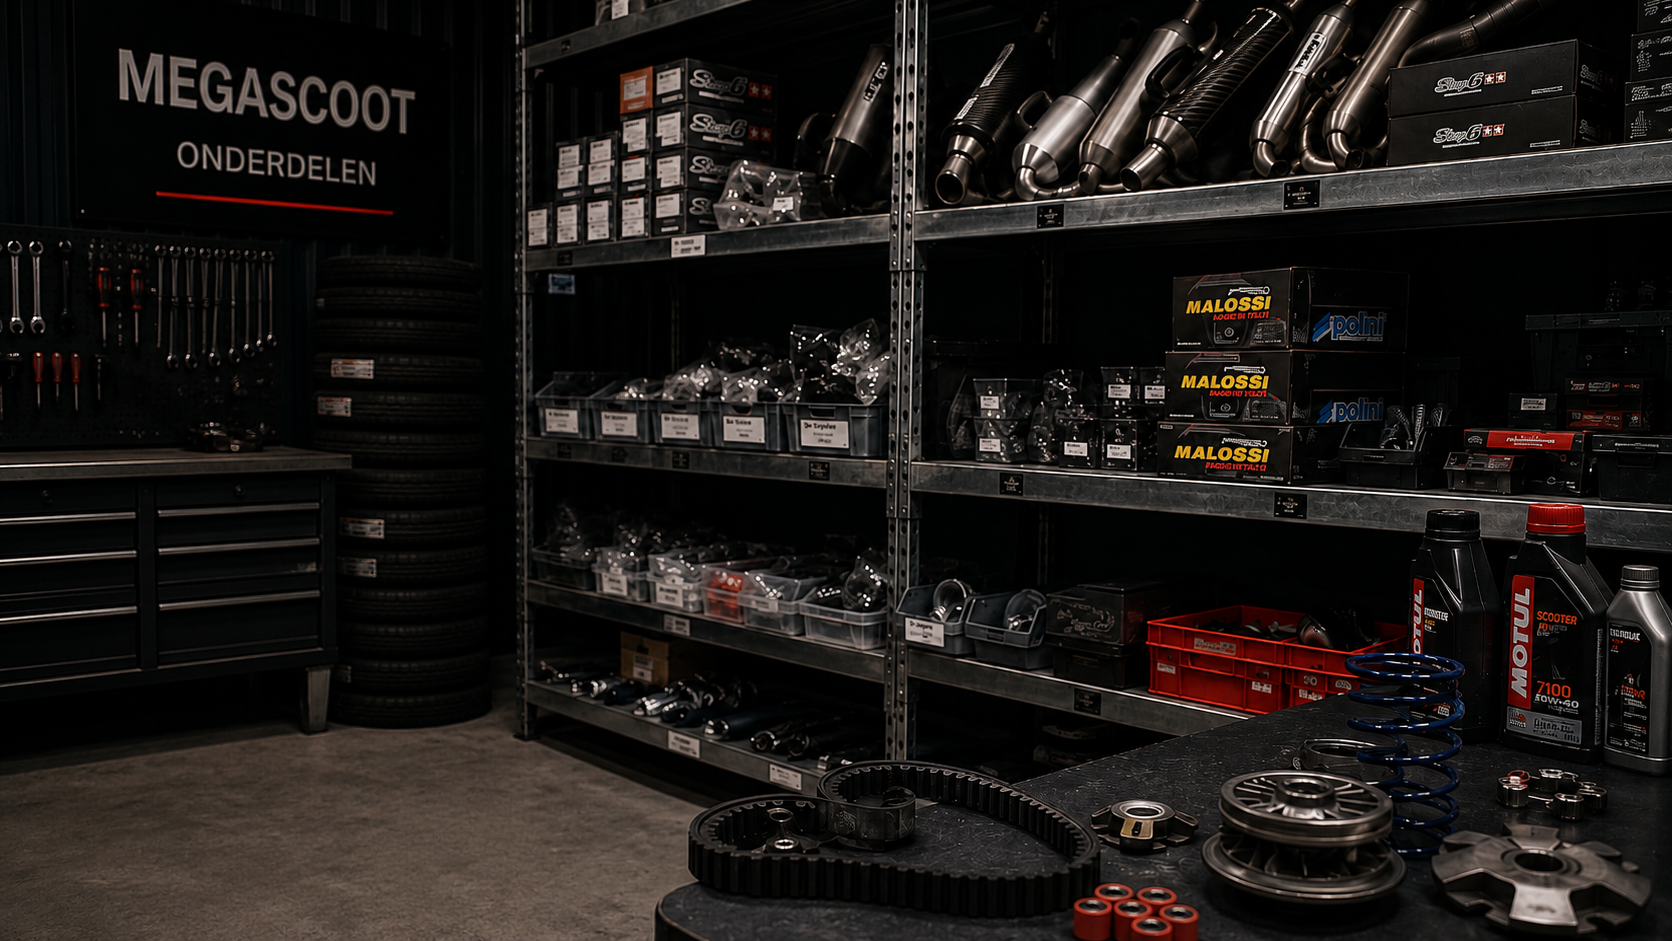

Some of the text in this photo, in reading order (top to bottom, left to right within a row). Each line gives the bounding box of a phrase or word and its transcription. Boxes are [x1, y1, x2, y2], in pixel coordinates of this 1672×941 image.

[118, 47, 416, 135] MEGASCOOT
[176, 140, 377, 187] ONDERDELEN
[1185, 295, 1272, 314] MALOSSI
[1331, 311, 1385, 341] polini
[1180, 375, 1270, 390] MALOSSI
[1331, 397, 1384, 423] polini
[1173, 445, 1270, 463] MALOSSI
[1413, 589, 1422, 654] OTUL
[1536, 610, 1578, 626] SCOOTER
[1511, 587, 1531, 699] MOTUL
[1536, 680, 1572, 699] 7100
